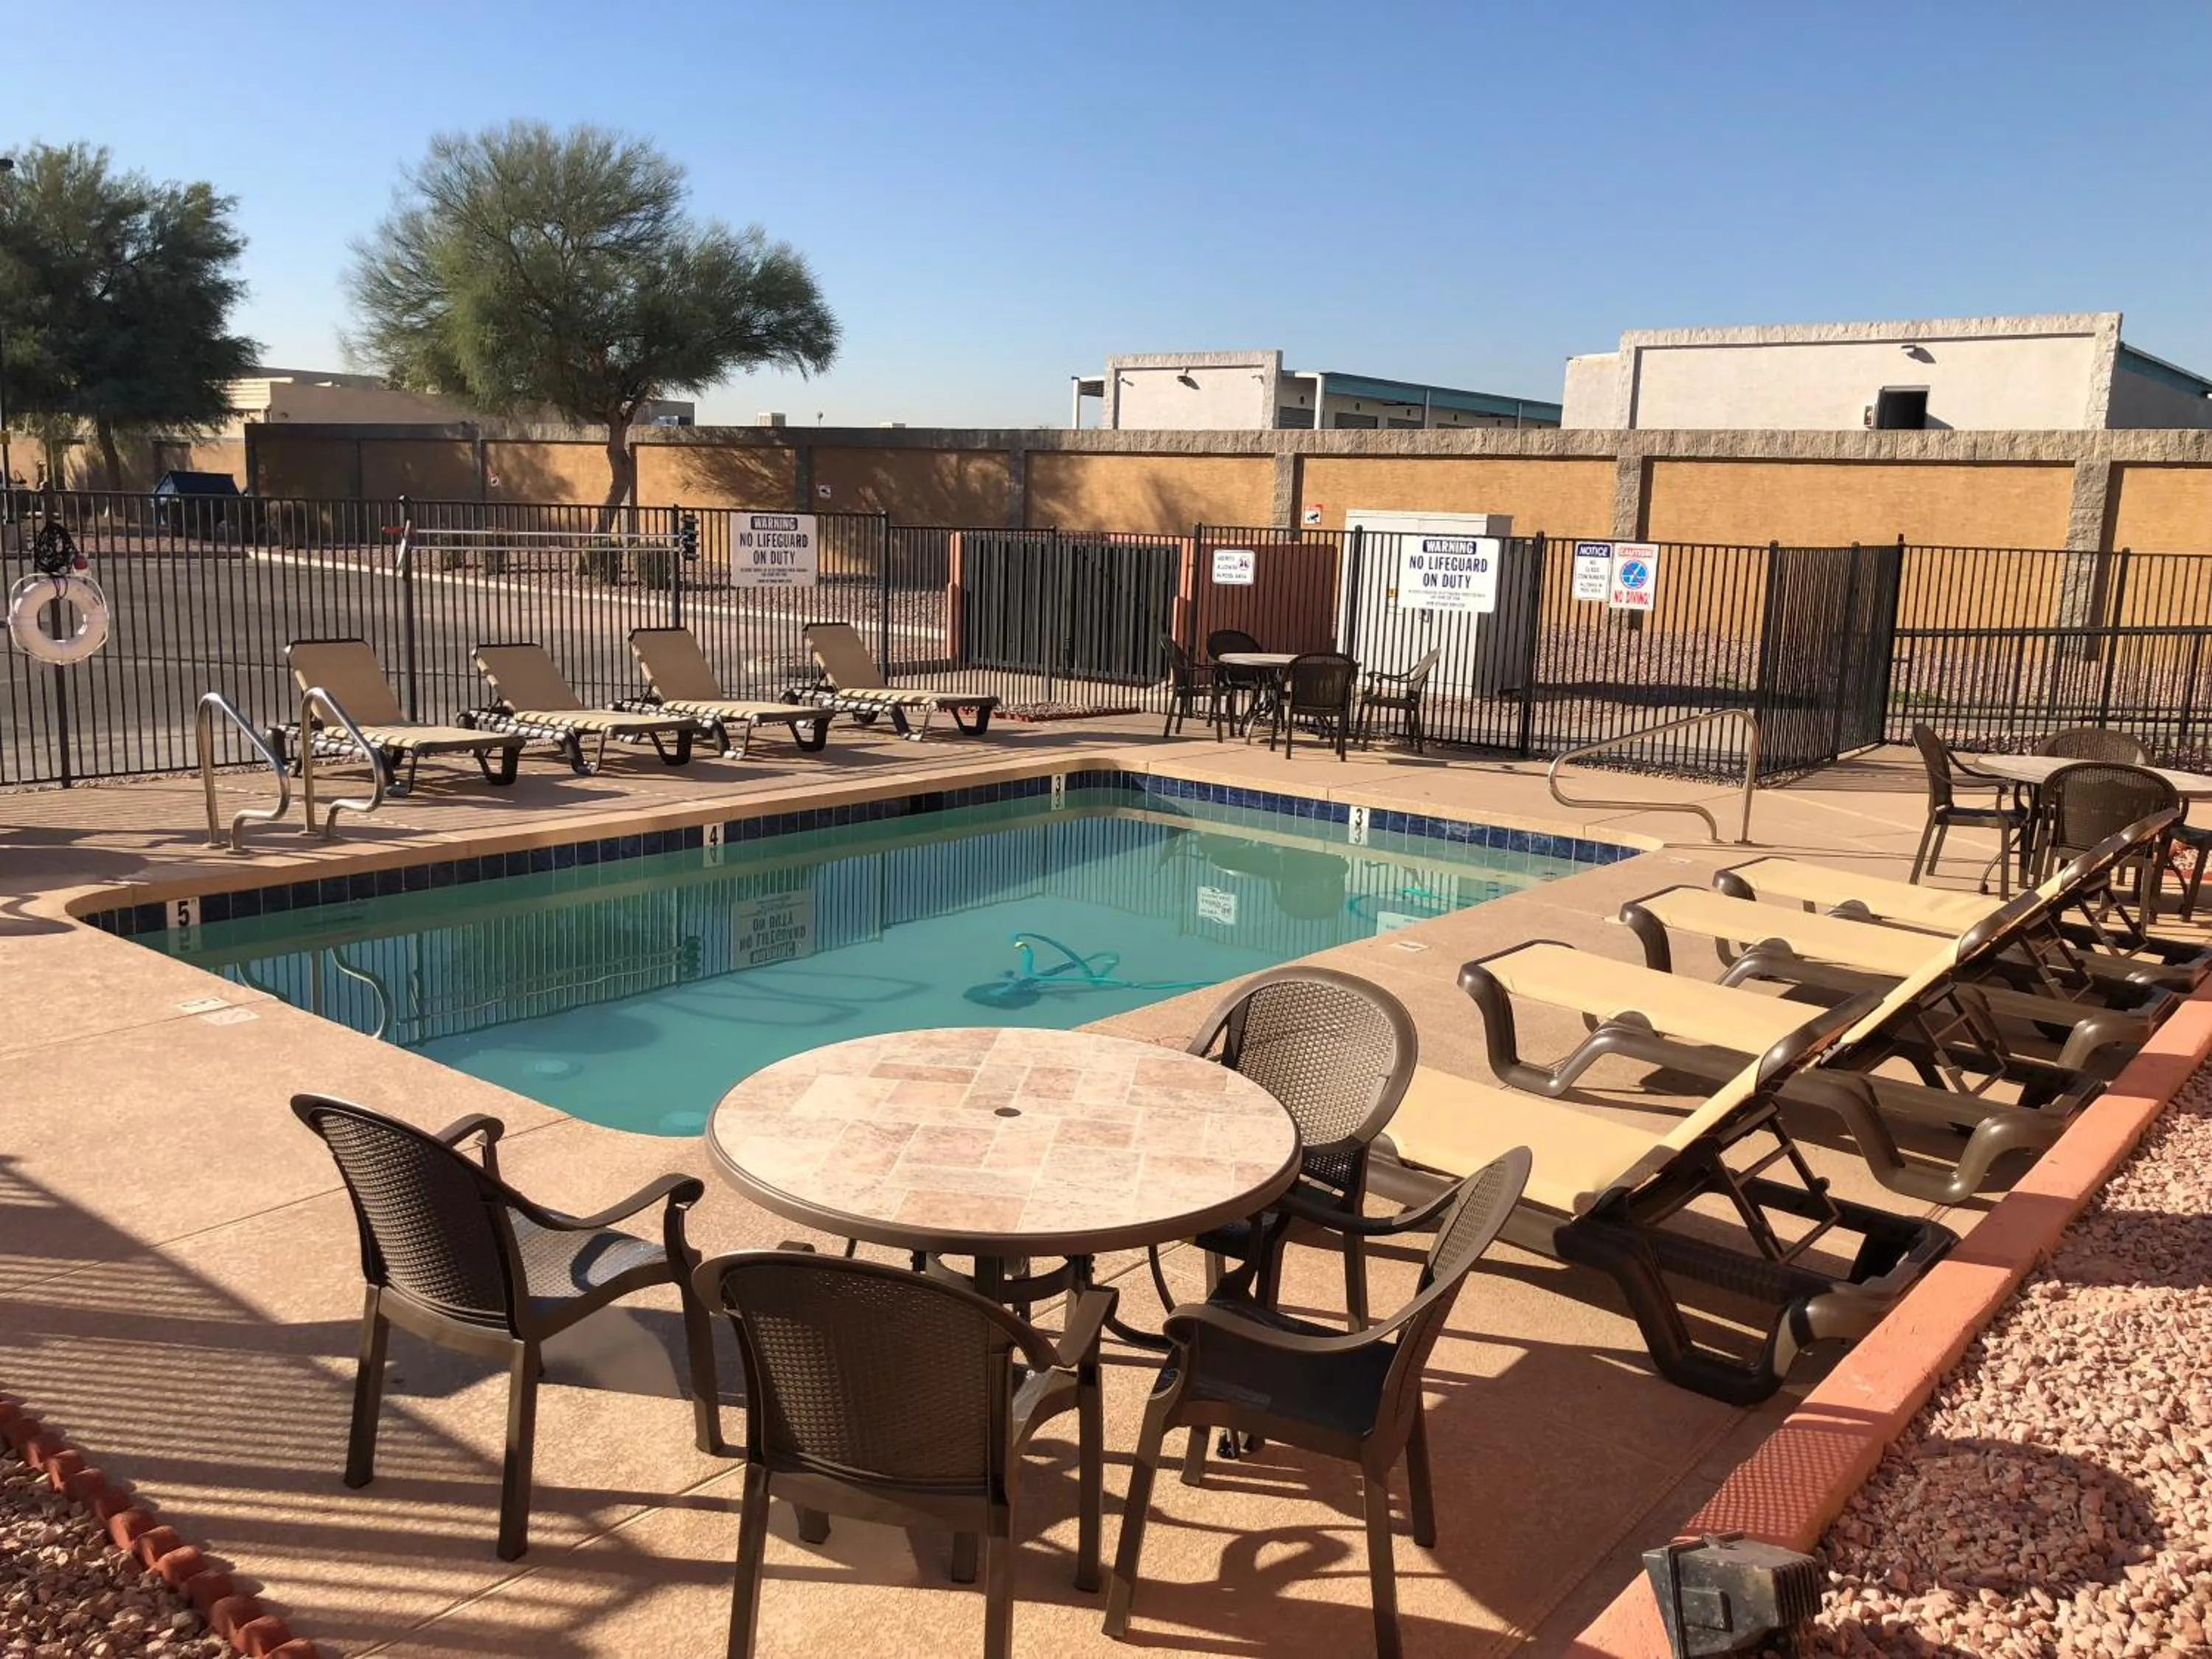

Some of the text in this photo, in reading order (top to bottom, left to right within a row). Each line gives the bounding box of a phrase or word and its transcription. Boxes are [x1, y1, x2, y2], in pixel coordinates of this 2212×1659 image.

[754, 517, 796, 529] WARNING
[740, 532, 809, 547] NO LIFEGUARD
[1426, 540, 1474, 554] WARNING
[753, 550, 796, 564] ON DUTY
[1579, 546, 1608, 556] NOTICE
[1409, 555, 1488, 572] NO LIFEGUARD
[1422, 573, 1471, 588] ON DUTY
[1614, 589, 1624, 603] NO
[1354, 807, 1363, 827] 3
[709, 825, 719, 846] 4
[178, 900, 189, 927] 5
